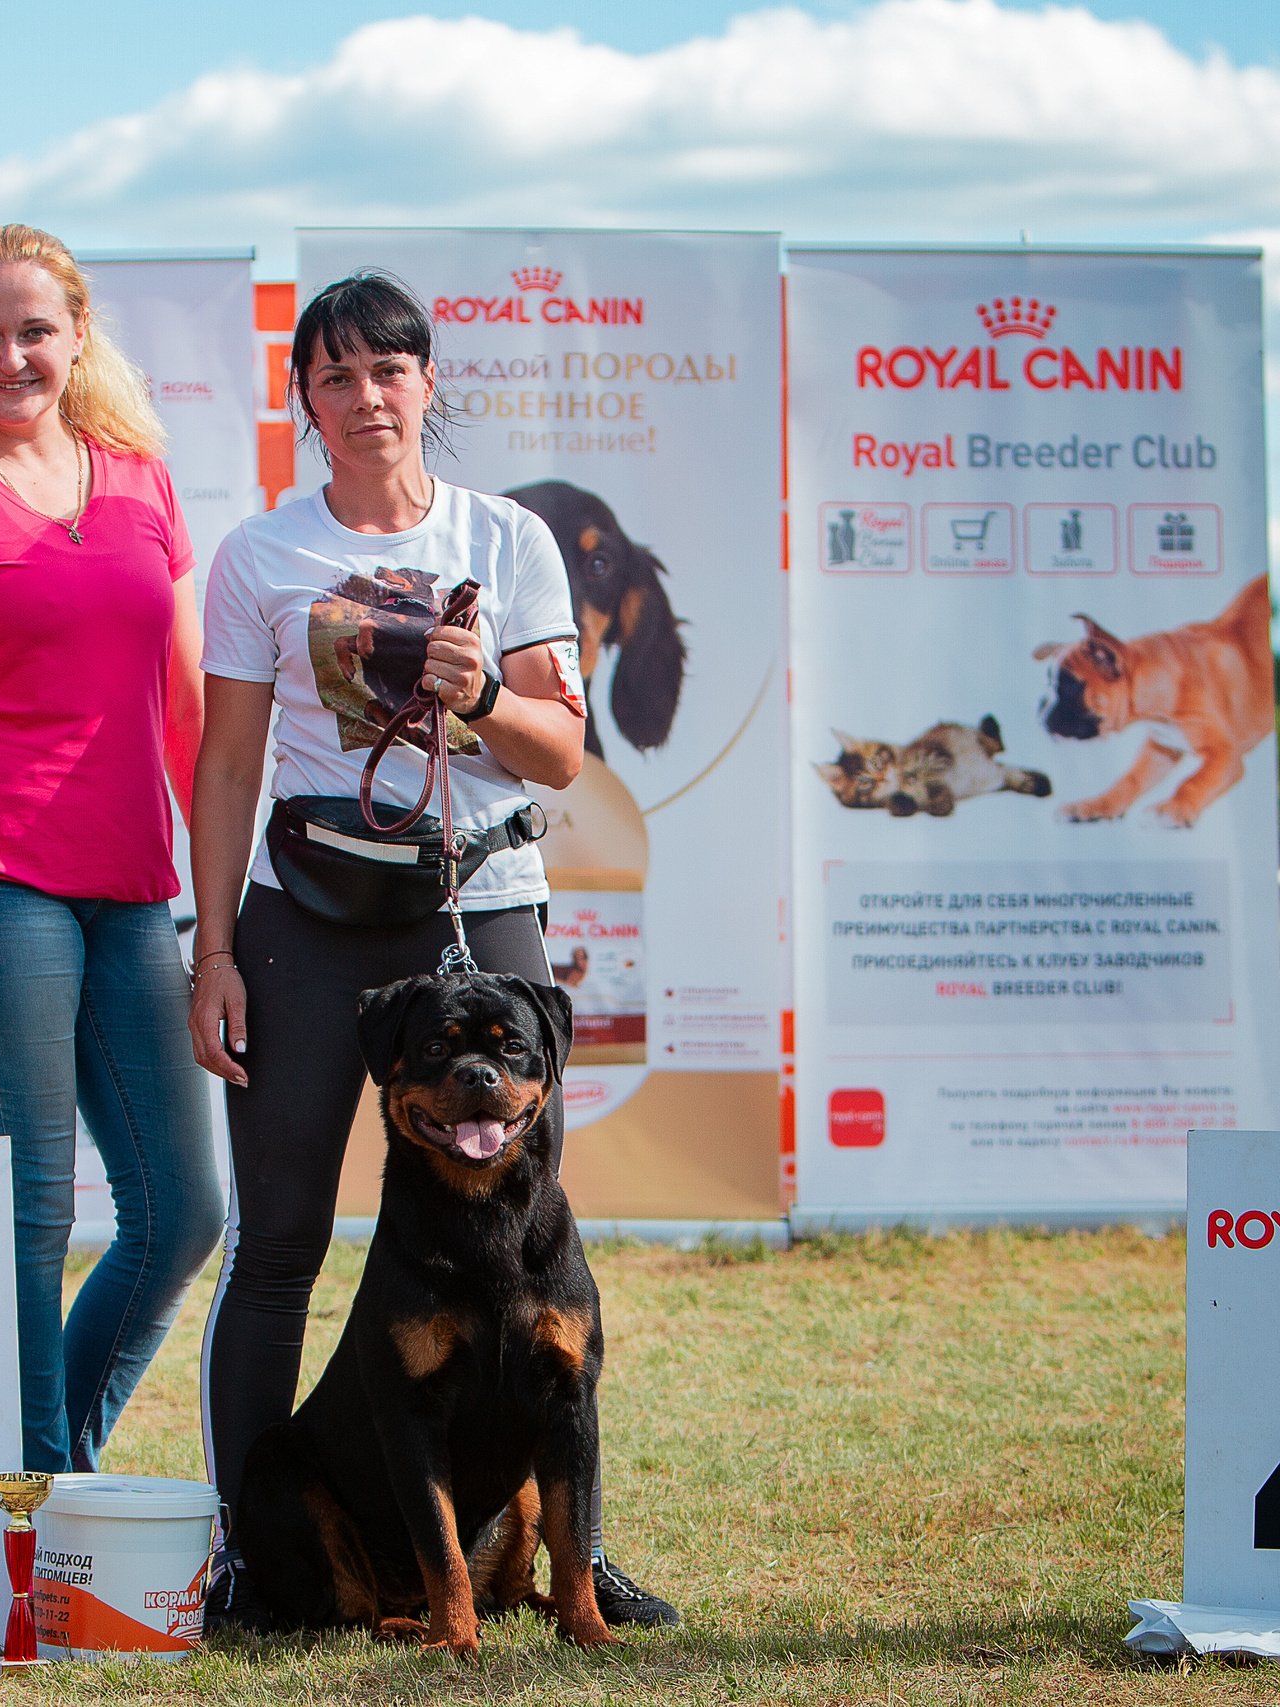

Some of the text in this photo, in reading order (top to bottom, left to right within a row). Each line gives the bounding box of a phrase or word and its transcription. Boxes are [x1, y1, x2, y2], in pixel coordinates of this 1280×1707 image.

[432, 296, 644, 325] ROYAL CANIN
[436, 352, 738, 385] аждой ПОРОДЫ
[856, 346, 1183, 391] ROYAL CANIN
[439, 388, 646, 420] СОБЕННОЕ
[508, 427, 656, 453] питание!
[853, 433, 1218, 477] Royal Breeder Club
[860, 890, 1195, 910] ОТКРОЙТЕ ДЛЯ СЕБЯ МНОГОЧИСЛЕННЫЕ
[833, 921, 970, 938] ПРЕИМУЩЕСТВА
[975, 920, 1092, 936] ПАРТНЕРСТВА
[1111, 919, 1161, 934] ROYAL
[852, 950, 1204, 970] ПРИСОЕДИНЯЙТЕСЬ К КЛУБУ ЗАВОДЧИКОВ
[936, 981, 987, 996] ROYAL
[992, 980, 1068, 996] BREEDER
[1207, 1208, 1280, 1250] RO
[44, 1550, 93, 1570] ПОДХОД
[34, 1566, 93, 1586] ПИТОМЦЕВ!
[144, 1590, 199, 1608] КОРМА
